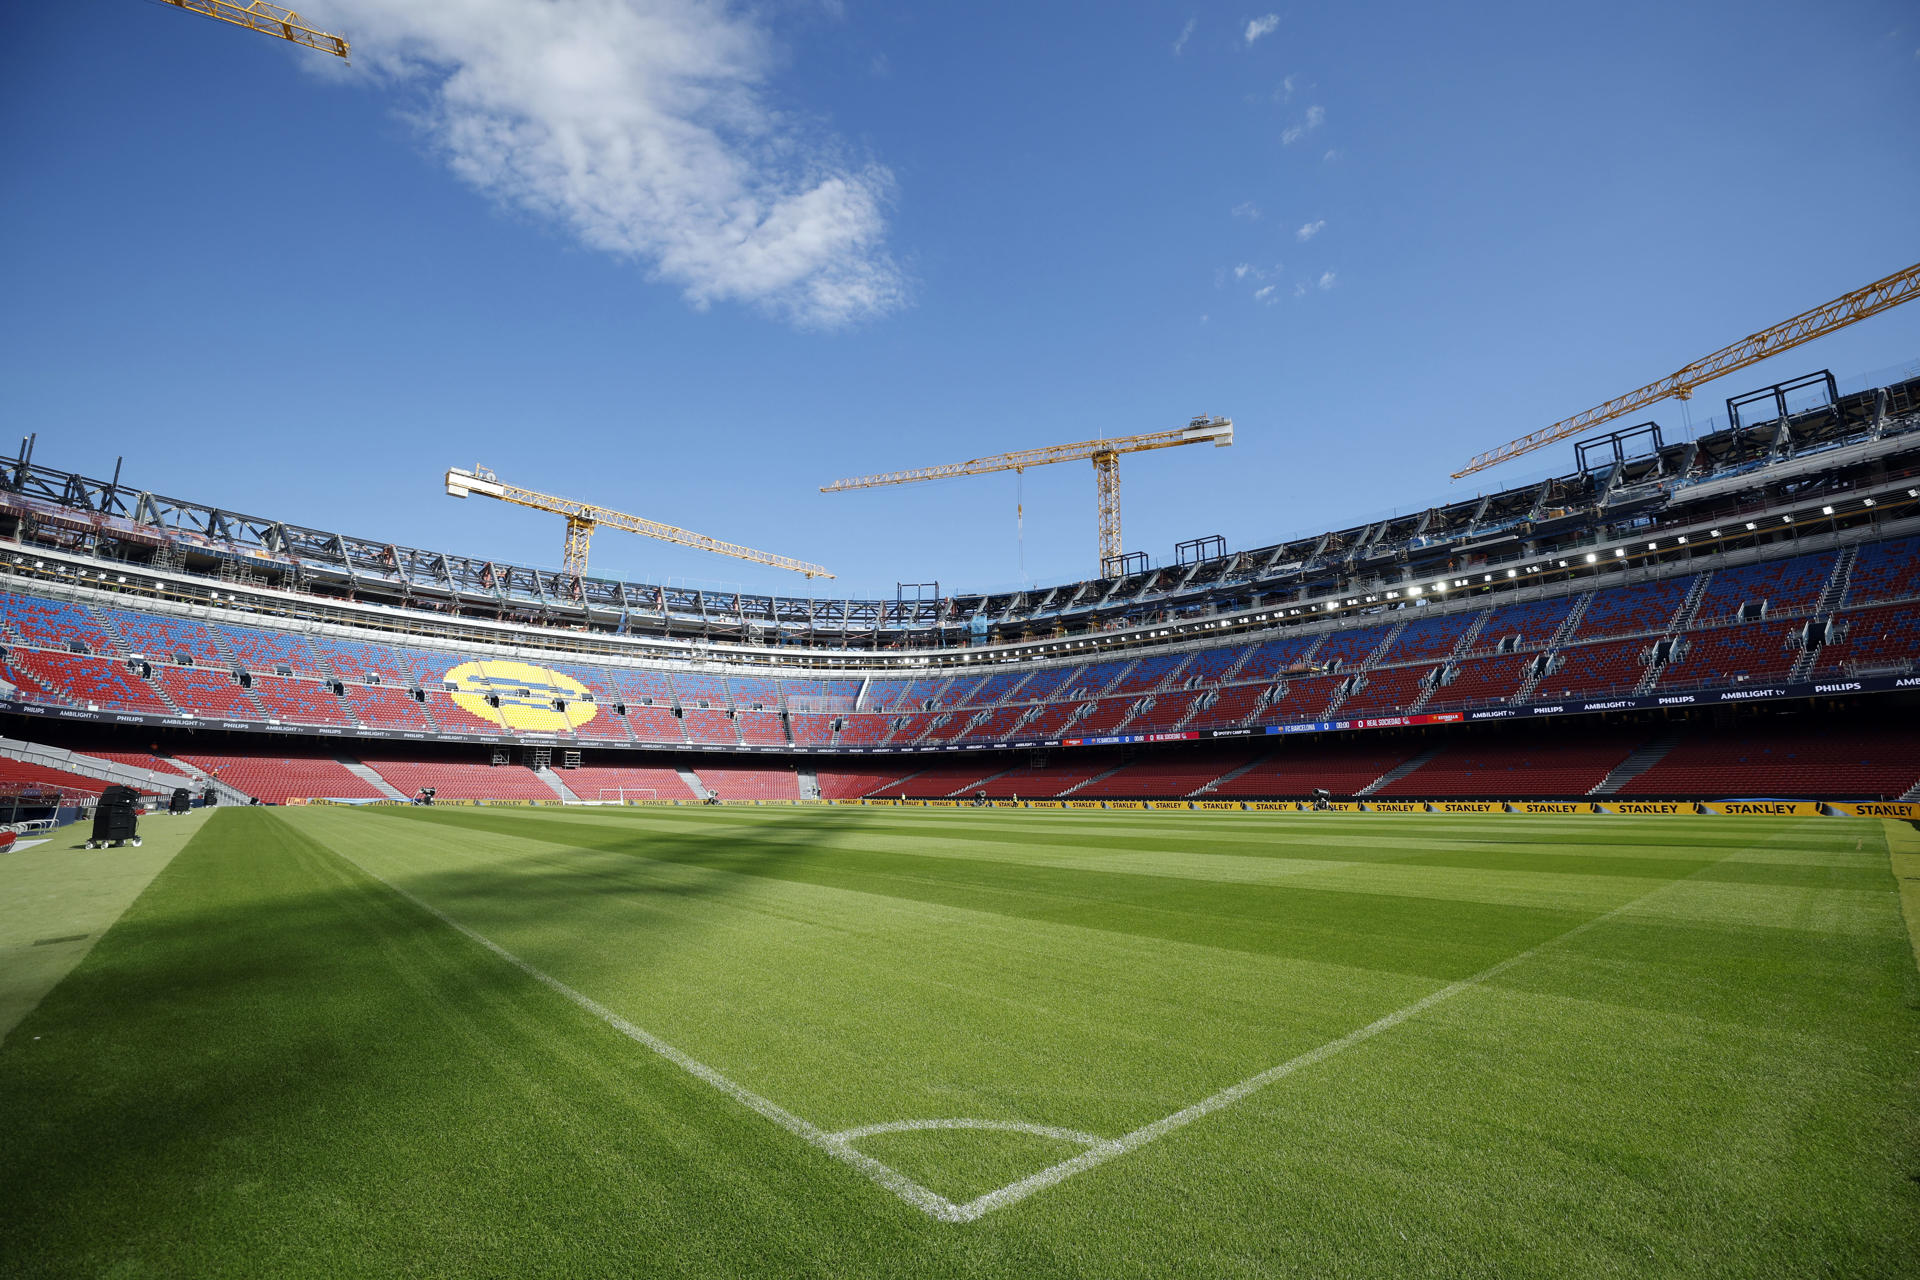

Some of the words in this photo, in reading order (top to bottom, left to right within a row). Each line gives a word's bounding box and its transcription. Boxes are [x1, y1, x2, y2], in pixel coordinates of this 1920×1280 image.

[1815, 682, 1861, 692] PHILIPS
[1721, 690, 1773, 699] AMBILIGHT
[1659, 696, 1695, 704] PHILIPS
[1534, 706, 1563, 714] PHILIPS
[1584, 701, 1626, 710] AMBILIGHT
[1378, 717, 1401, 726] SOCIEDAD
[1291, 724, 1315, 732] BARCELONA
[1619, 805, 1677, 813] STANLEY
[1725, 805, 1796, 814] STANLEY
[1856, 805, 1912, 816] STANLEY
